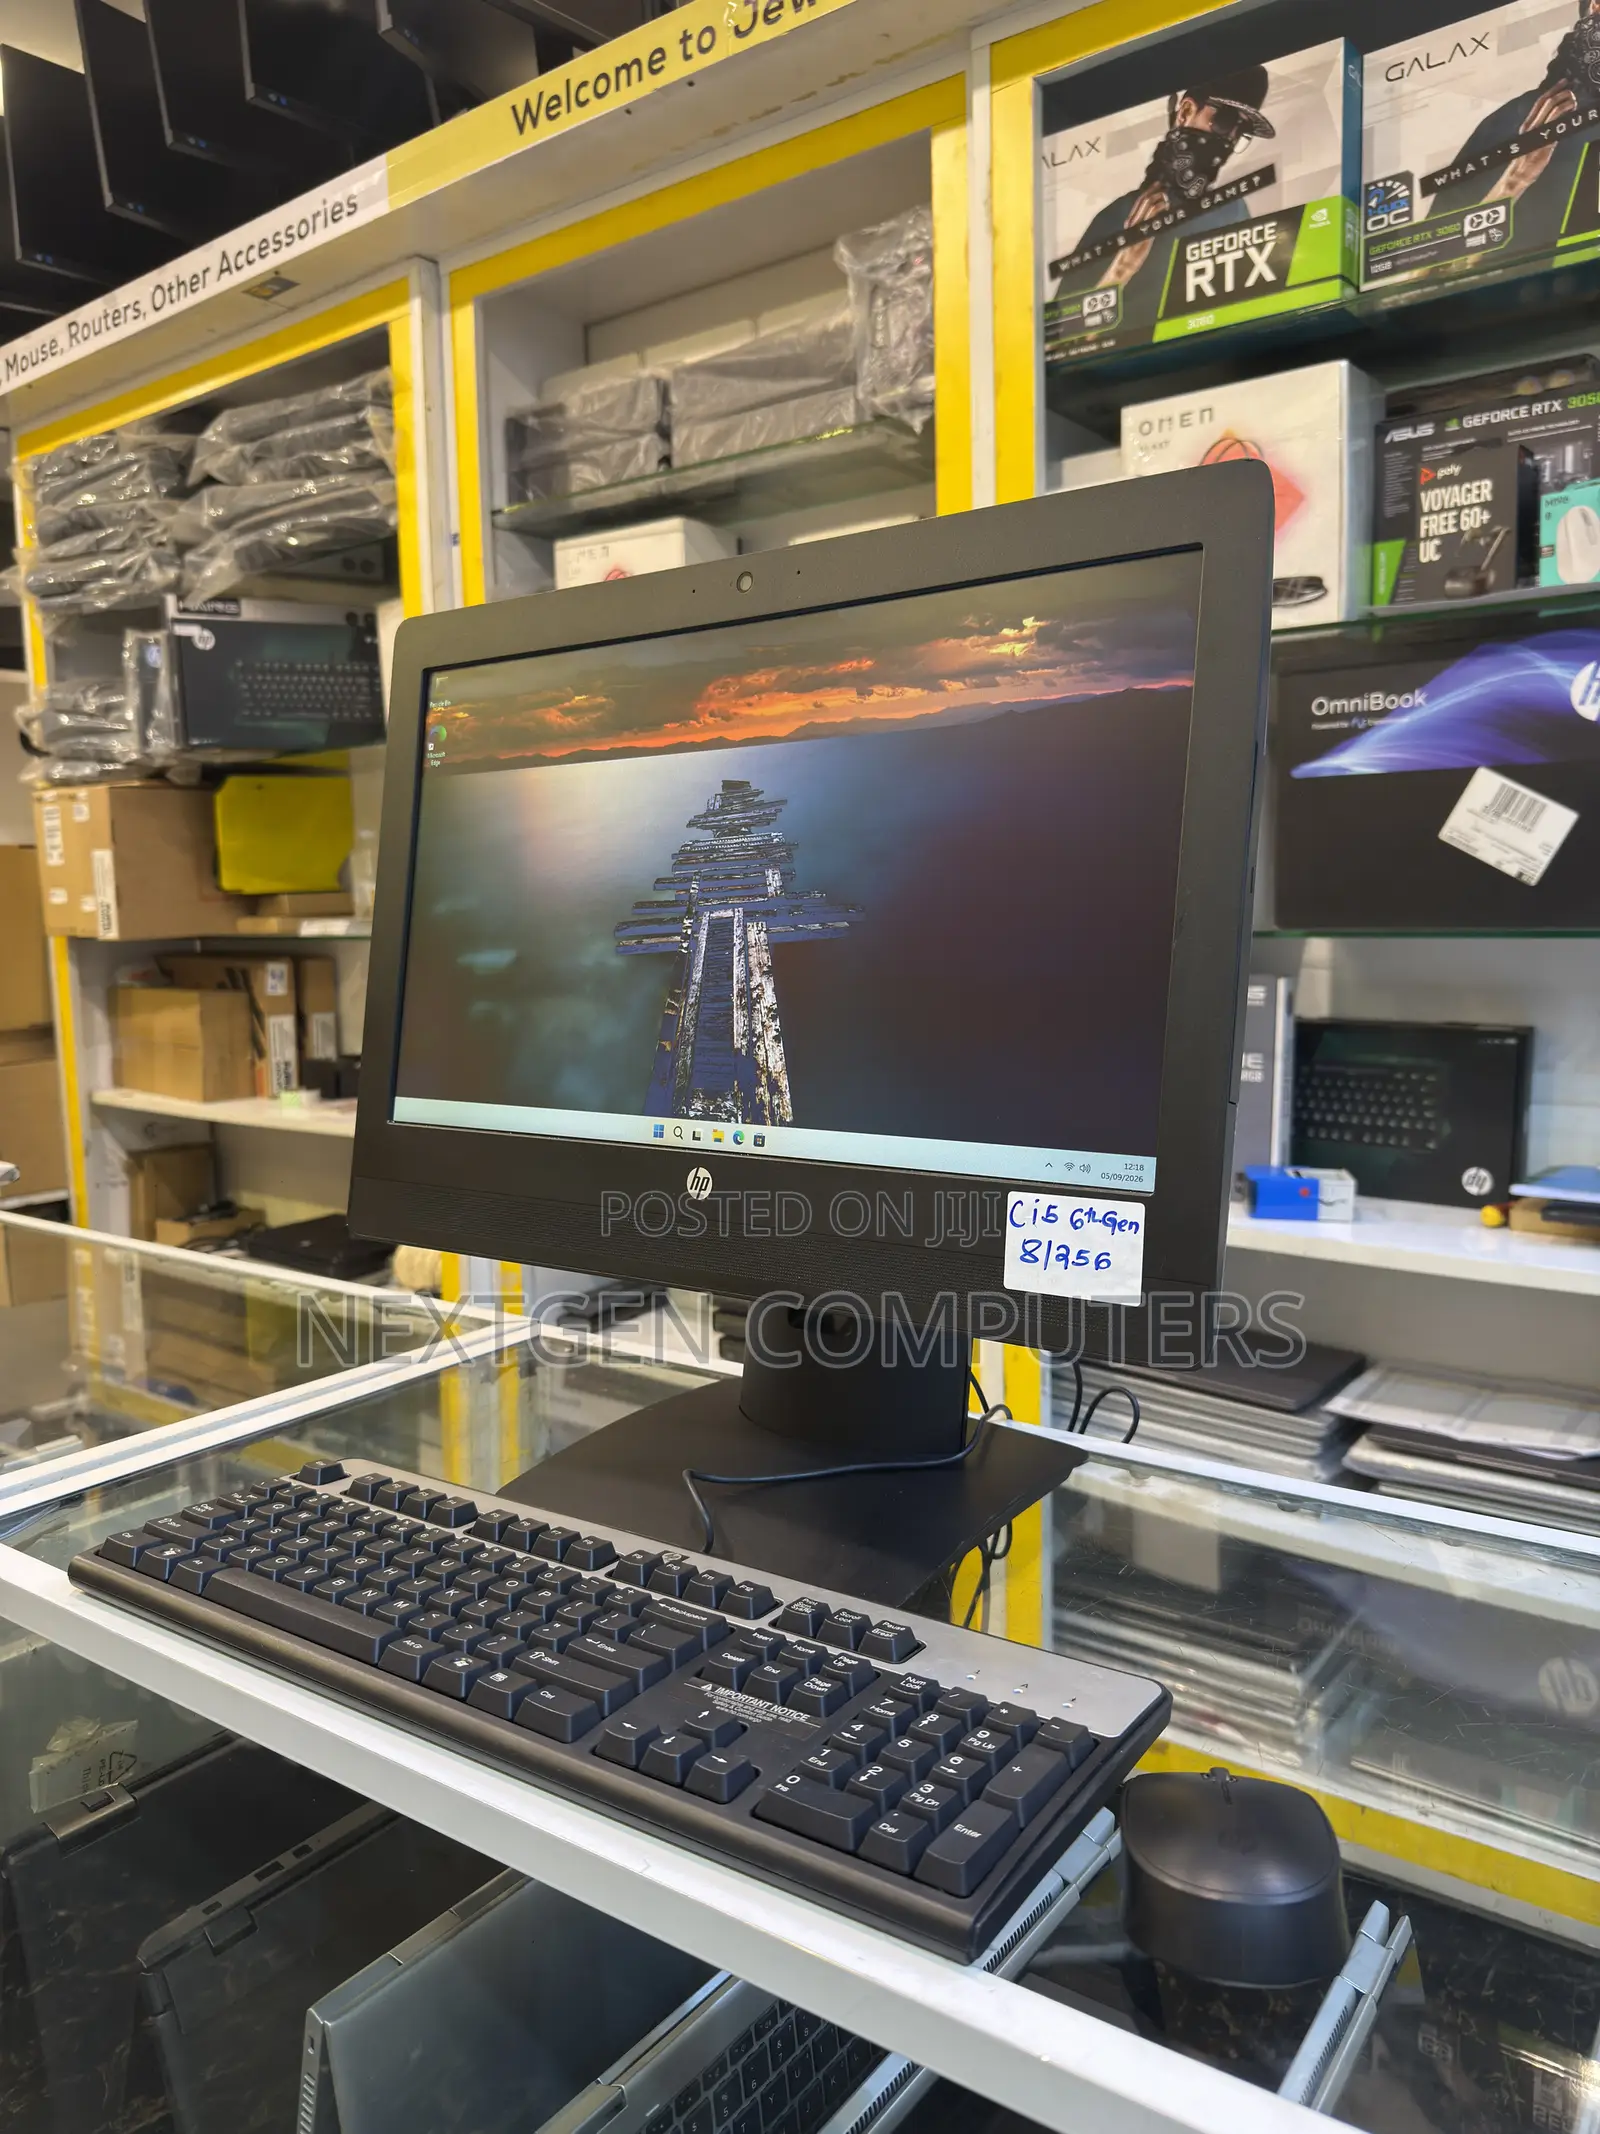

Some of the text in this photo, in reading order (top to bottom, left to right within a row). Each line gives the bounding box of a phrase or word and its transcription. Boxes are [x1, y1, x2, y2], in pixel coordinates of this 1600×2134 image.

[1385, 31, 1490, 82] GALAX
[510, 46, 667, 135] Welcome
[678, 25, 716, 62] to
[1435, 109, 1598, 187] WHAT'S YOUR
[1140, 208, 1187, 236] YOUR
[1201, 175, 1261, 209] GAME?
[1367, 207, 1410, 231] OC
[1186, 221, 1278, 262] GEFORCE
[1369, 236, 1412, 256] GEFORCE
[1413, 230, 1433, 244] RTX
[1186, 242, 1277, 302] RTX
[5, 189, 358, 381] Mouse, Routers, Other Accessories
[1462, 391, 1600, 429] GEFORCE RTX 305
[1384, 422, 1435, 444] ASUS
[1436, 463, 1462, 480] poly
[1420, 478, 1493, 513] VOYAGER
[1420, 506, 1492, 539] FREE 60+
[1419, 539, 1442, 564] UC
[1311, 688, 1428, 716] OmniBook
[1124, 1162, 1145, 1172] 12:18
[1100, 1172, 1144, 1183] 05/09/2026
[689, 1167, 711, 1200] hp
[1019, 1238, 1112, 1271] 8/256
[220, 1536, 235, 1544] Z
[445, 1588, 460, 1596] K
[739, 1584, 754, 1592] F12
[538, 1590, 552, 1598] P
[393, 1600, 410, 1608] M
[478, 1600, 488, 1608] L
[668, 1606, 708, 1620] Backspace
[840, 1611, 862, 1620] Scroll
[834, 1615, 853, 1624] Lock
[883, 1621, 906, 1632] Pause
[752, 1632, 774, 1642] Insert
[872, 1628, 895, 1638] Break
[792, 1644, 816, 1654] Home
[542, 1656, 560, 1666] Shift
[833, 1659, 846, 1668] Up
[838, 1655, 858, 1665] Page
[764, 1665, 781, 1674] End
[810, 1677, 832, 1688] Page
[900, 1680, 922, 1690] Lock
[906, 1676, 927, 1686] Num
[804, 1681, 828, 1692] Down
[715, 1687, 811, 1721] IMPORTANT NOTICE
[880, 1698, 894, 1706] 7
[870, 1704, 896, 1716] Home
[926, 1714, 940, 1722] 8
[850, 1724, 865, 1732] 4
[976, 1730, 991, 1739] 9
[898, 1738, 912, 1748] 5
[967, 1737, 996, 1750] Pg Up
[820, 1748, 832, 1756] 1
[808, 1756, 828, 1767] End
[950, 1756, 964, 1765] 6
[868, 1766, 884, 1776] 2
[785, 1776, 800, 1784] 0
[775, 1784, 790, 1792] Ins
[920, 1784, 935, 1794] 3
[910, 1792, 940, 1808] Pg Dn
[878, 1822, 899, 1834] Del
[954, 1823, 982, 1839] Enter
[751, 2080, 757, 2089] 6
